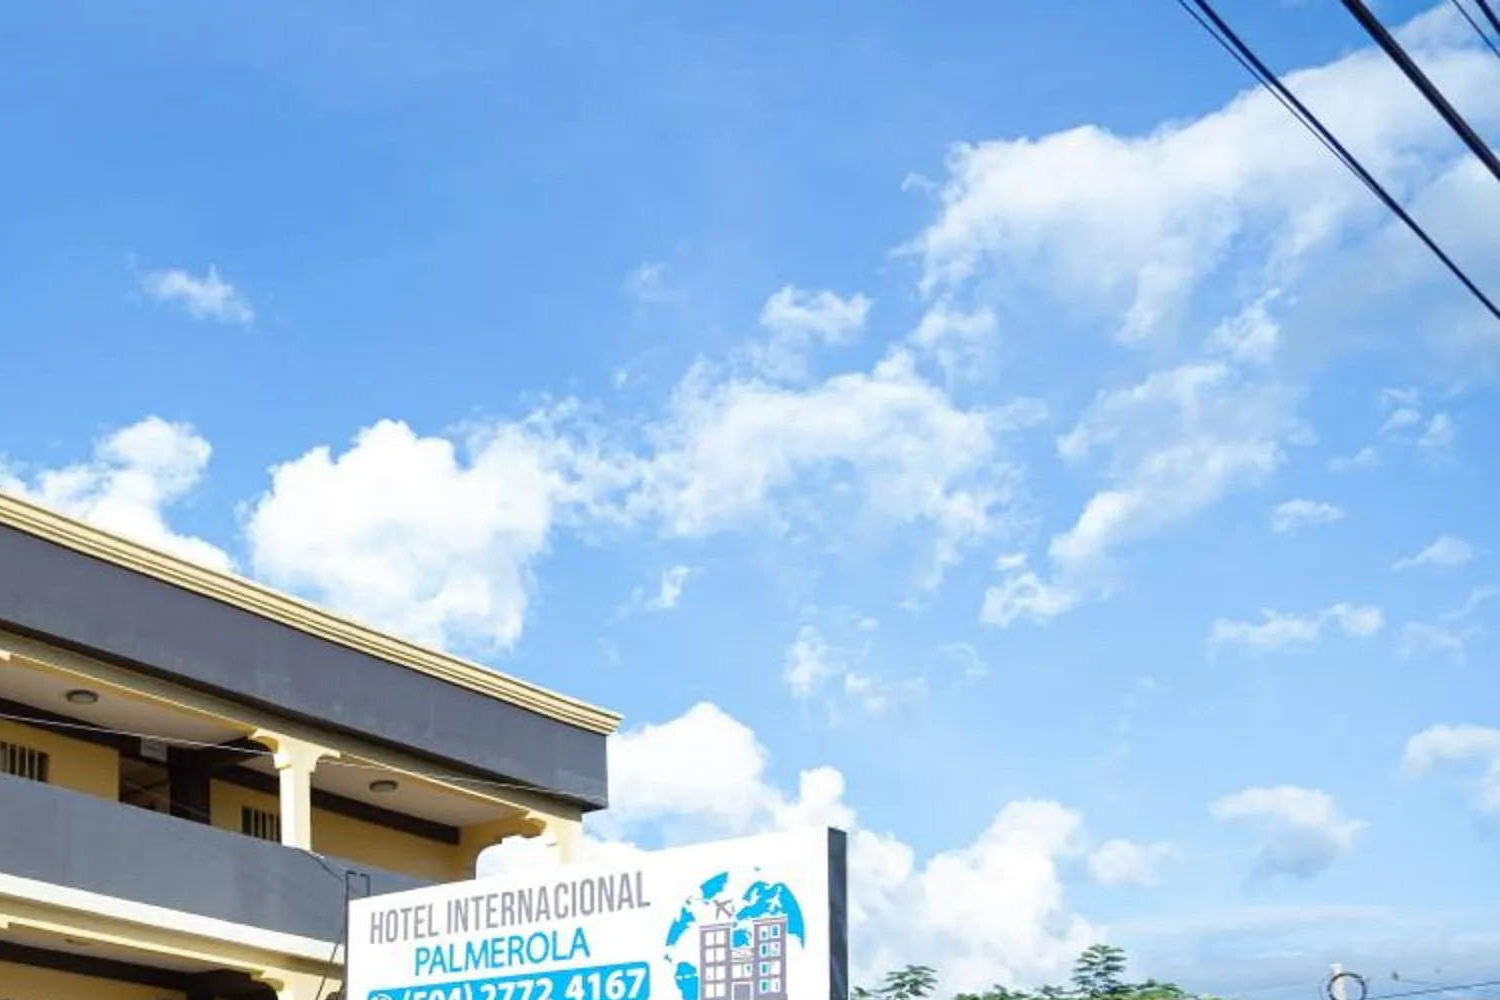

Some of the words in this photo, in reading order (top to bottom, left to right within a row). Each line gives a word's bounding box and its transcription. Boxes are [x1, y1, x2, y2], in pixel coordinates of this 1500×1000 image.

[369, 902, 439, 944] HOTEL
[446, 870, 651, 934] INTERNACIONAL
[414, 926, 591, 977] PALMEROLA
